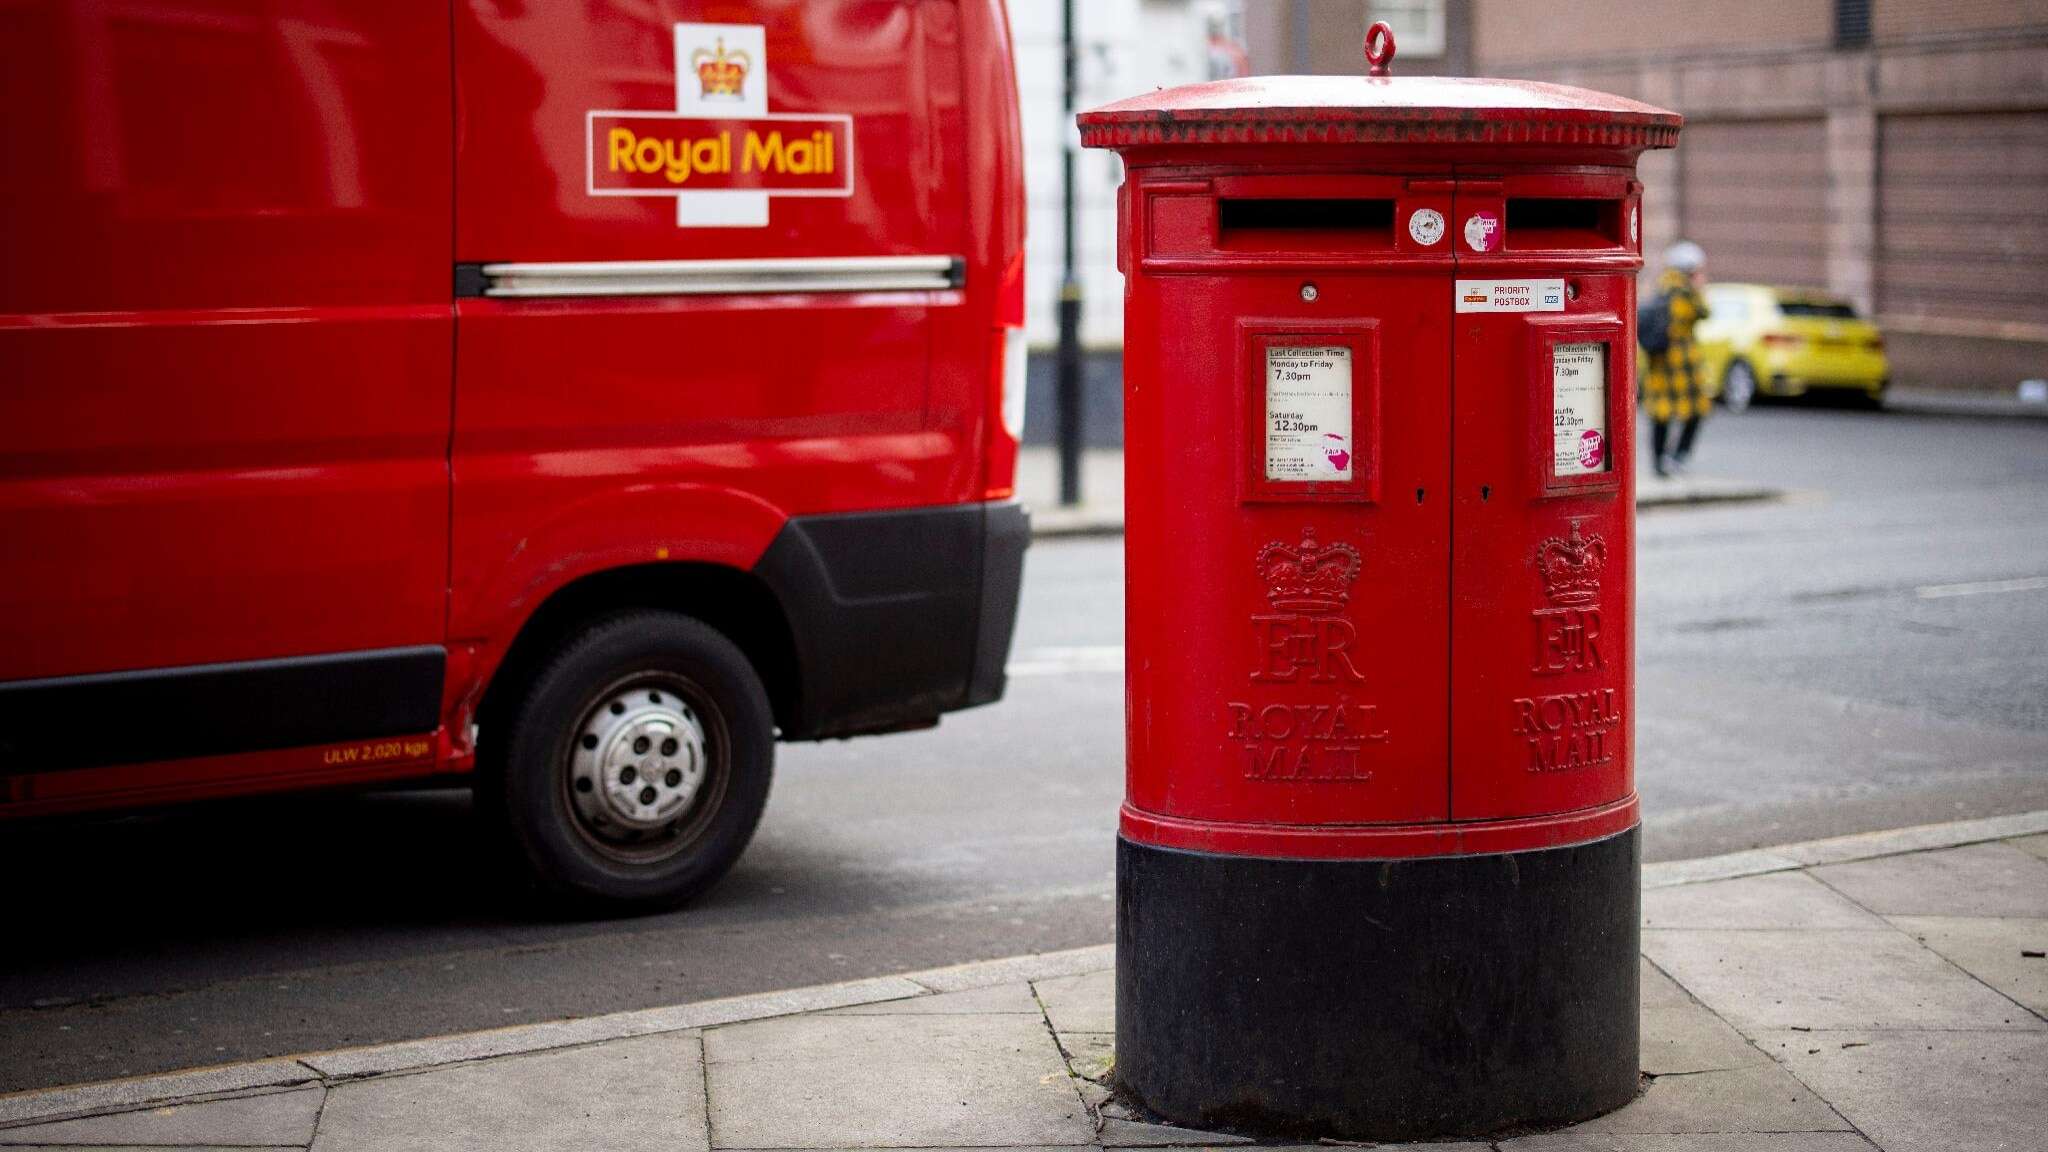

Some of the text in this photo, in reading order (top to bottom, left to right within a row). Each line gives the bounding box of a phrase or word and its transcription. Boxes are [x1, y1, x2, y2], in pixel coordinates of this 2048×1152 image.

[608, 127, 833, 183] Royal Mail
[1494, 286, 1530, 295] PRIORITY
[1494, 297, 1530, 306] POSTBOX
[1544, 295, 1559, 304] NHS
[1270, 349, 1345, 357] Last Collection Time
[1270, 360, 1334, 369] Monday to Friday
[1577, 356, 1593, 364] Friday
[1275, 369, 1311, 381] 7.30pm
[1555, 366, 1579, 377] 7.30pm
[1269, 411, 1303, 420] Saturday
[1555, 415, 1584, 426] 12.30pm
[1274, 420, 1318, 432] 12.30pm
[1513, 688, 1620, 732] ROYAL
[1227, 702, 1390, 741] ROYAL
[324, 747, 359, 764] ULW
[1527, 729, 1614, 772] MAIL
[1243, 744, 1373, 782] MAIL
